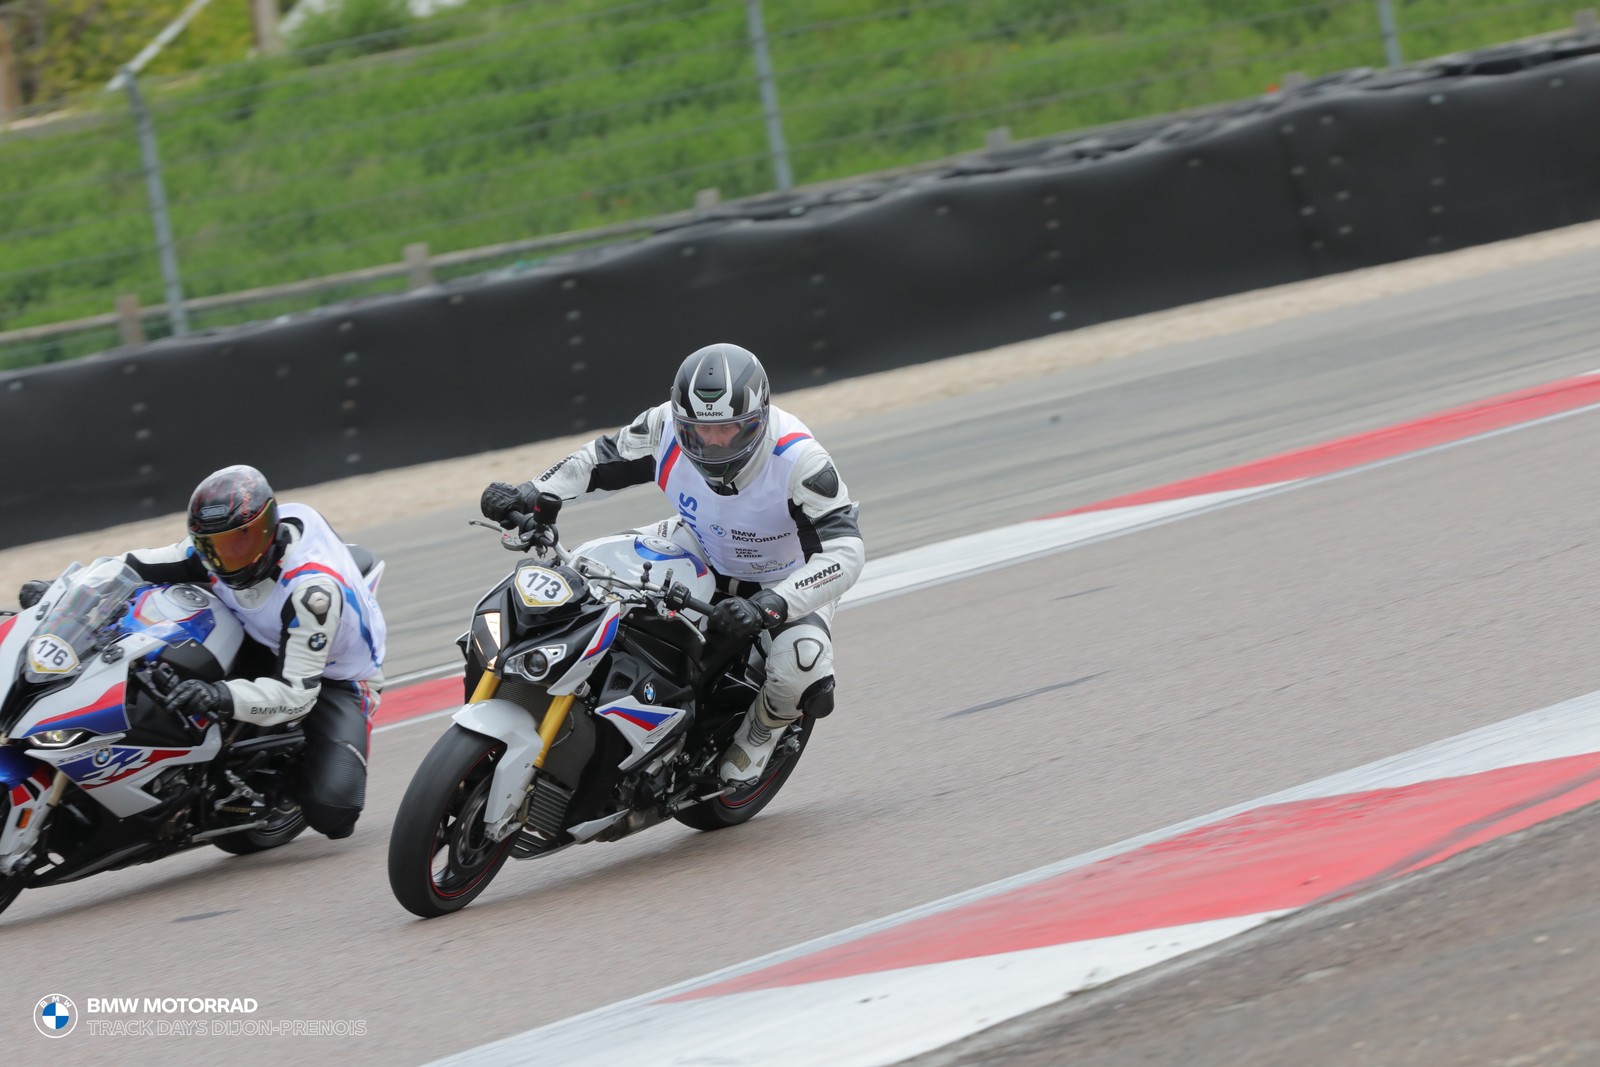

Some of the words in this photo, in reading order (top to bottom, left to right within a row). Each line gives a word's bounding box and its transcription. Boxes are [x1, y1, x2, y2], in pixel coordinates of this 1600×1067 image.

[731, 529, 756, 538] BMW
[732, 532, 791, 543] MOTORRAD
[526, 572, 561, 599] 173
[36, 640, 68, 666] 176
[250, 706, 277, 715] BMW
